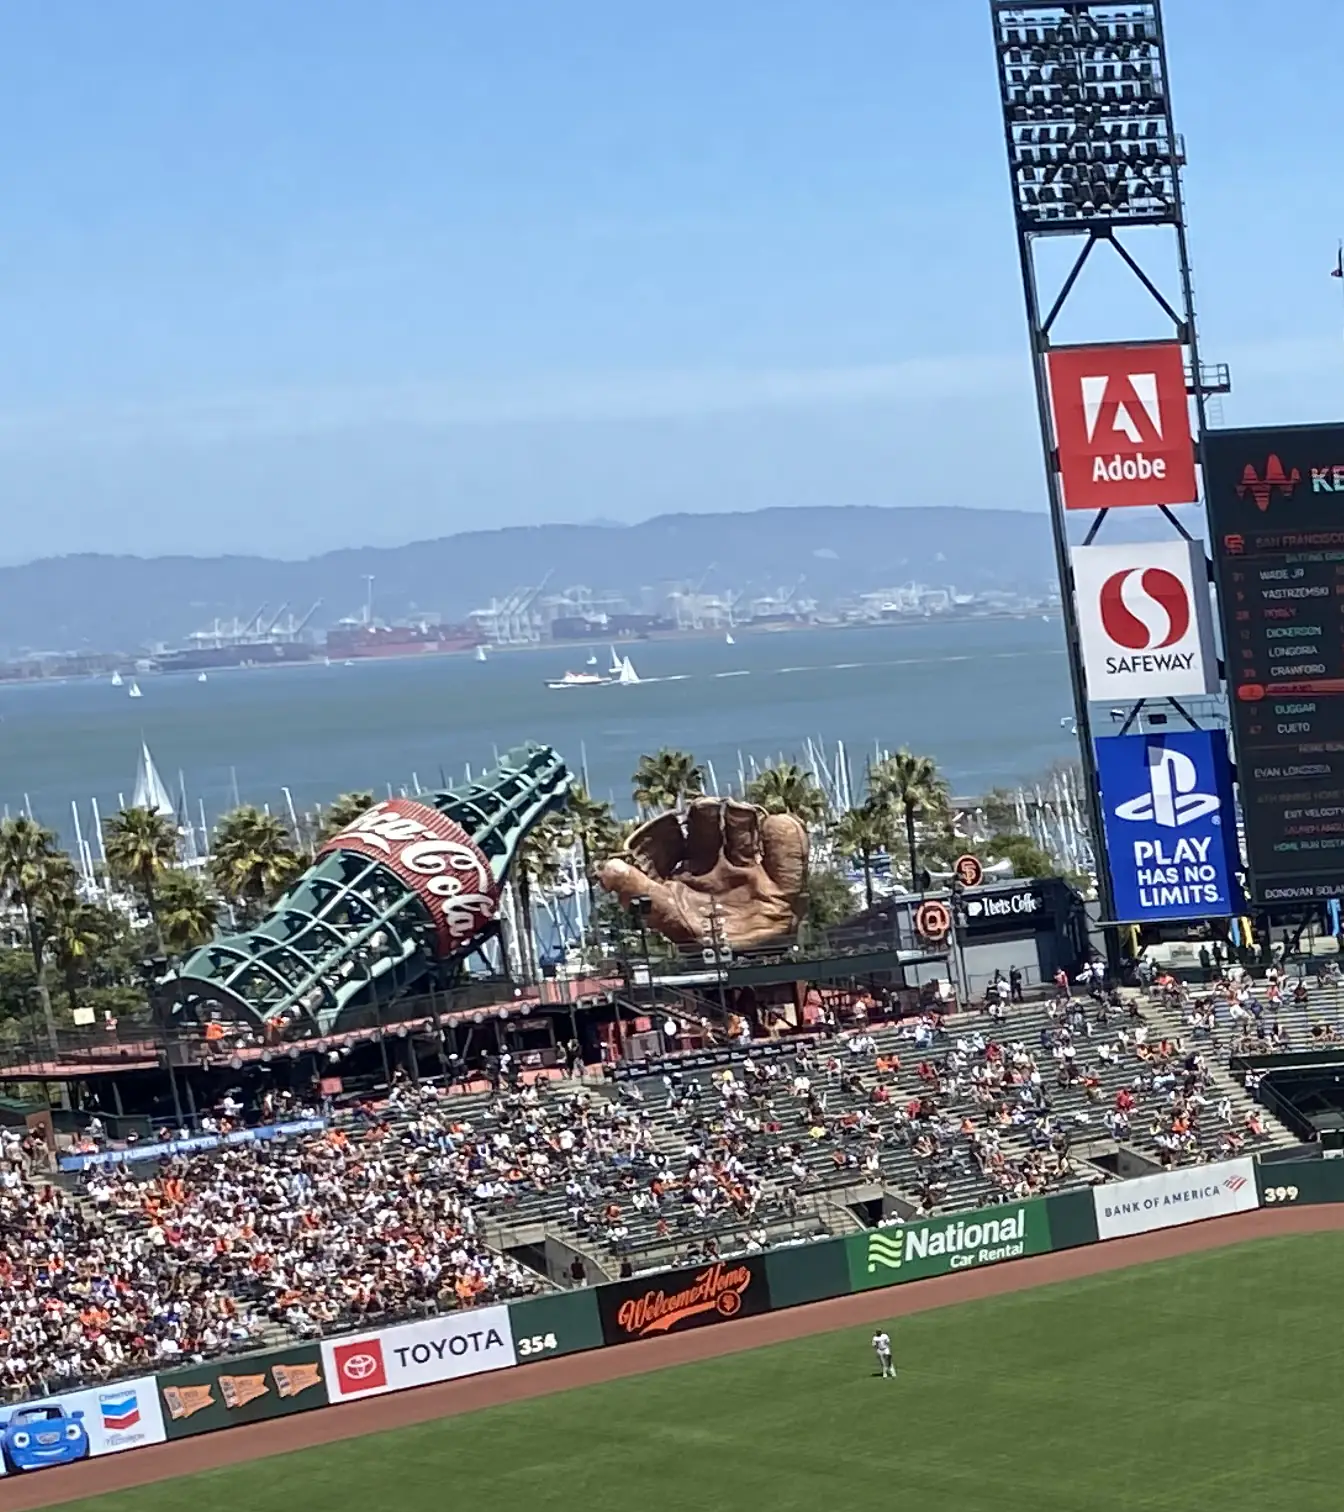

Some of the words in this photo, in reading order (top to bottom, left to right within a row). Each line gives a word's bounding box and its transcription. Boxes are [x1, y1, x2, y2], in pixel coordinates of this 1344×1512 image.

[1092, 452, 1166, 482] Adobe
[1106, 653, 1194, 674] SAFEWAY
[1134, 838, 1211, 867] PLAY
[1138, 869, 1178, 886] HAS
[1185, 865, 1216, 882] NO
[1140, 885, 1219, 907] LIMITS
[1105, 1202, 1140, 1218] BANK
[1142, 1198, 1160, 1209] OF
[1163, 1186, 1220, 1205] AMERICA
[1264, 1186, 1298, 1201] 399
[904, 1210, 1025, 1261] National
[950, 1254, 974, 1269] Car
[978, 1242, 1024, 1262] Rental
[617, 1288, 704, 1332] Welcome
[394, 1328, 503, 1367] TOYOTA
[518, 1333, 557, 1356] 354
